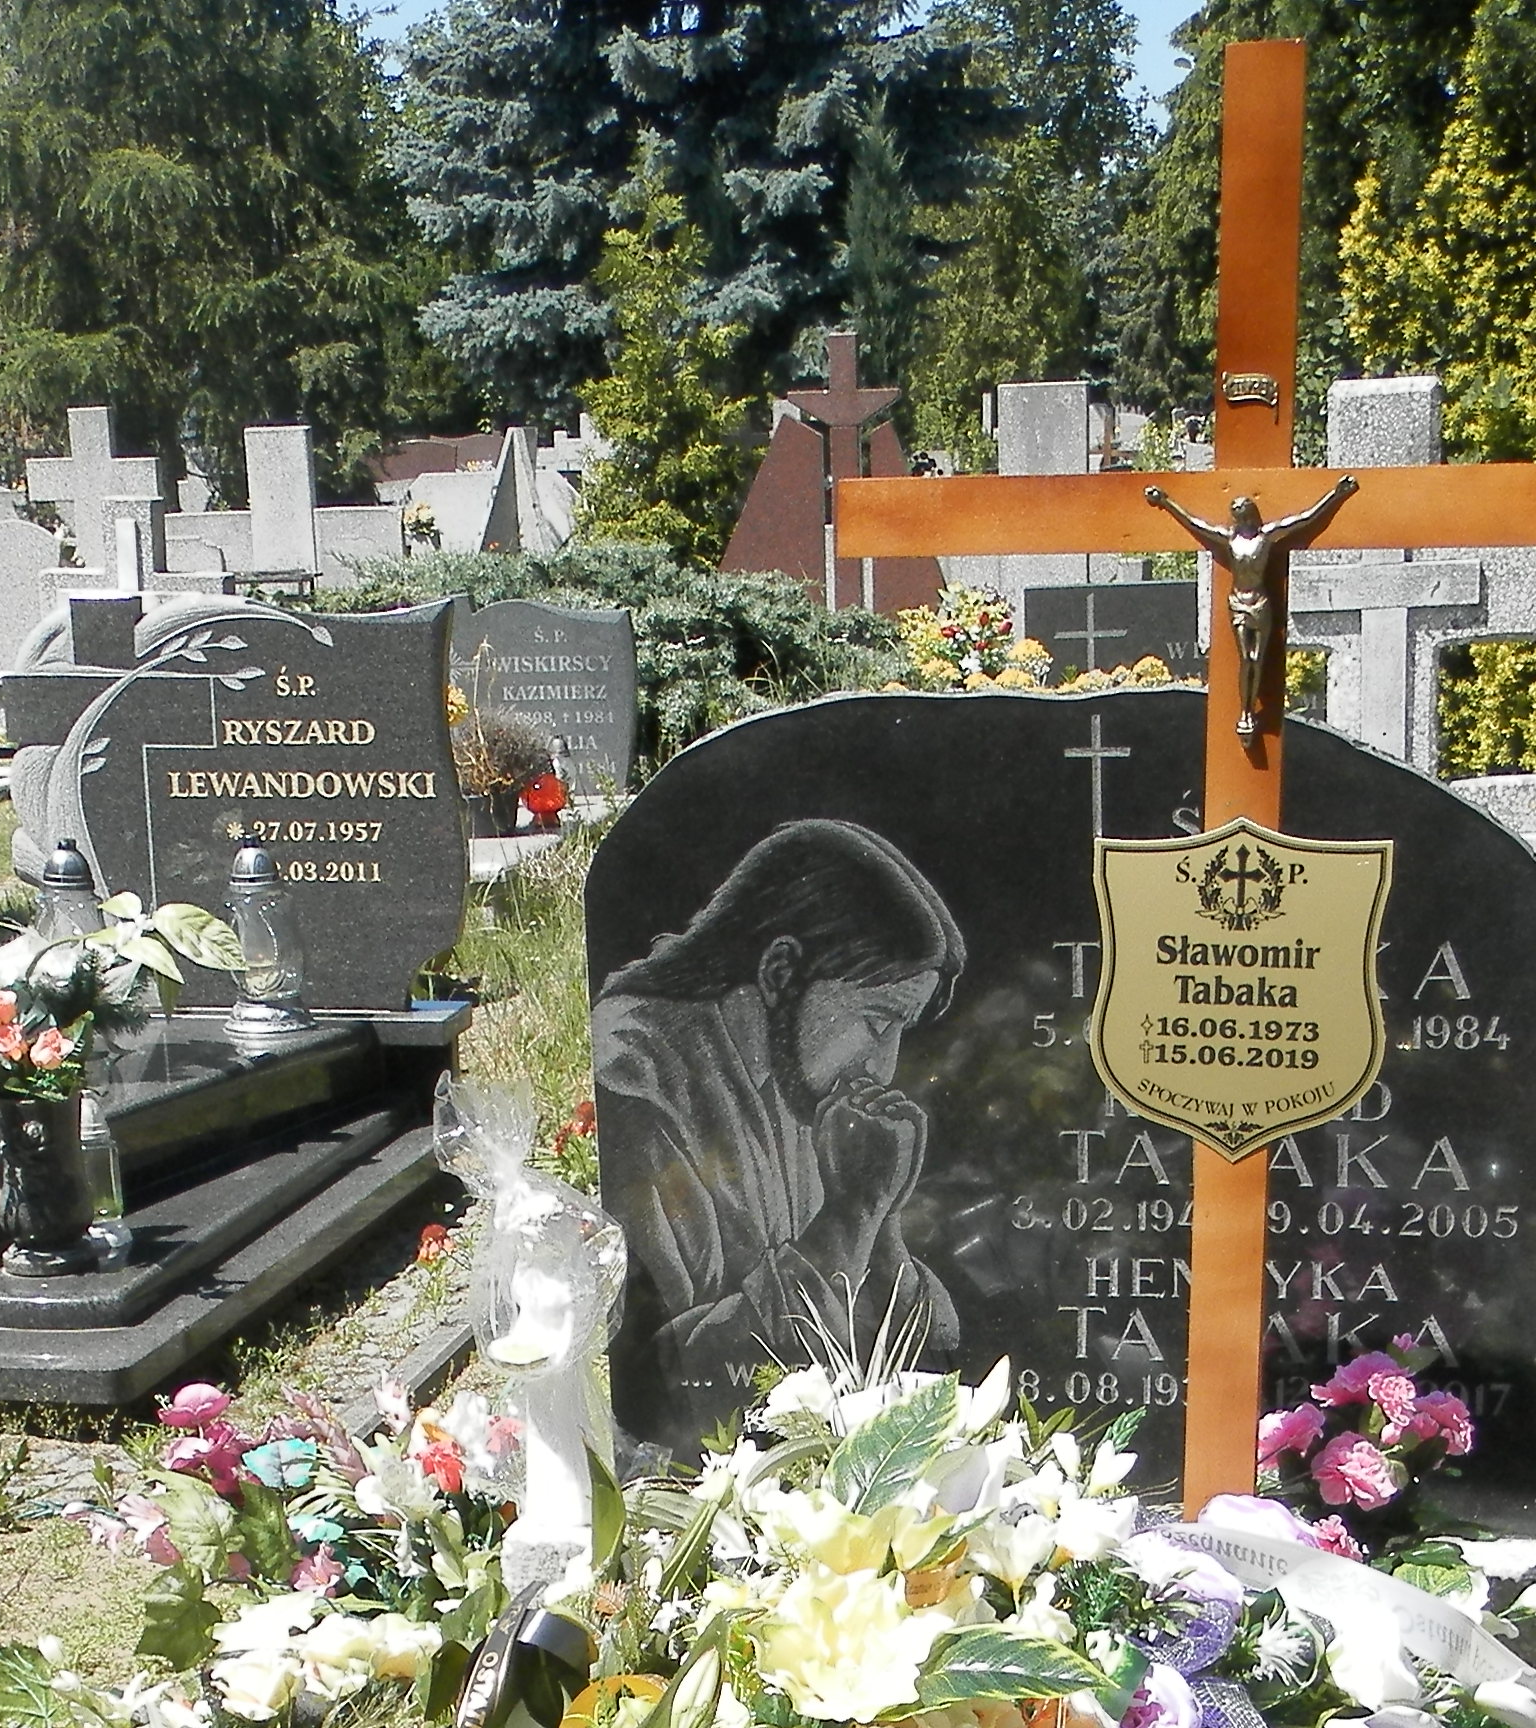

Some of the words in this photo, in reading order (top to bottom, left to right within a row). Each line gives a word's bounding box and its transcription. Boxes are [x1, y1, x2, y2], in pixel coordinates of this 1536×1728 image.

[502, 685, 608, 700] KAZIMIERZ
[221, 718, 376, 746] RYSZARD
[167, 770, 438, 799] LEWANDOWSKI
[1156, 935, 1321, 970] Sławomir
[1174, 975, 1298, 1008] Tabaka
[1156, 1017, 1320, 1042] 16.06.1973
[1154, 1044, 1319, 1070] 15.06.2019
[1137, 1077, 1235, 1118] SPOCZYWAJ
[1242, 1101, 1259, 1117] W
[1265, 1081, 1336, 1115] POKOJU
[1059, 1130, 1471, 1191] TAAKA
[1058, 1305, 1459, 1368] TAAKA
